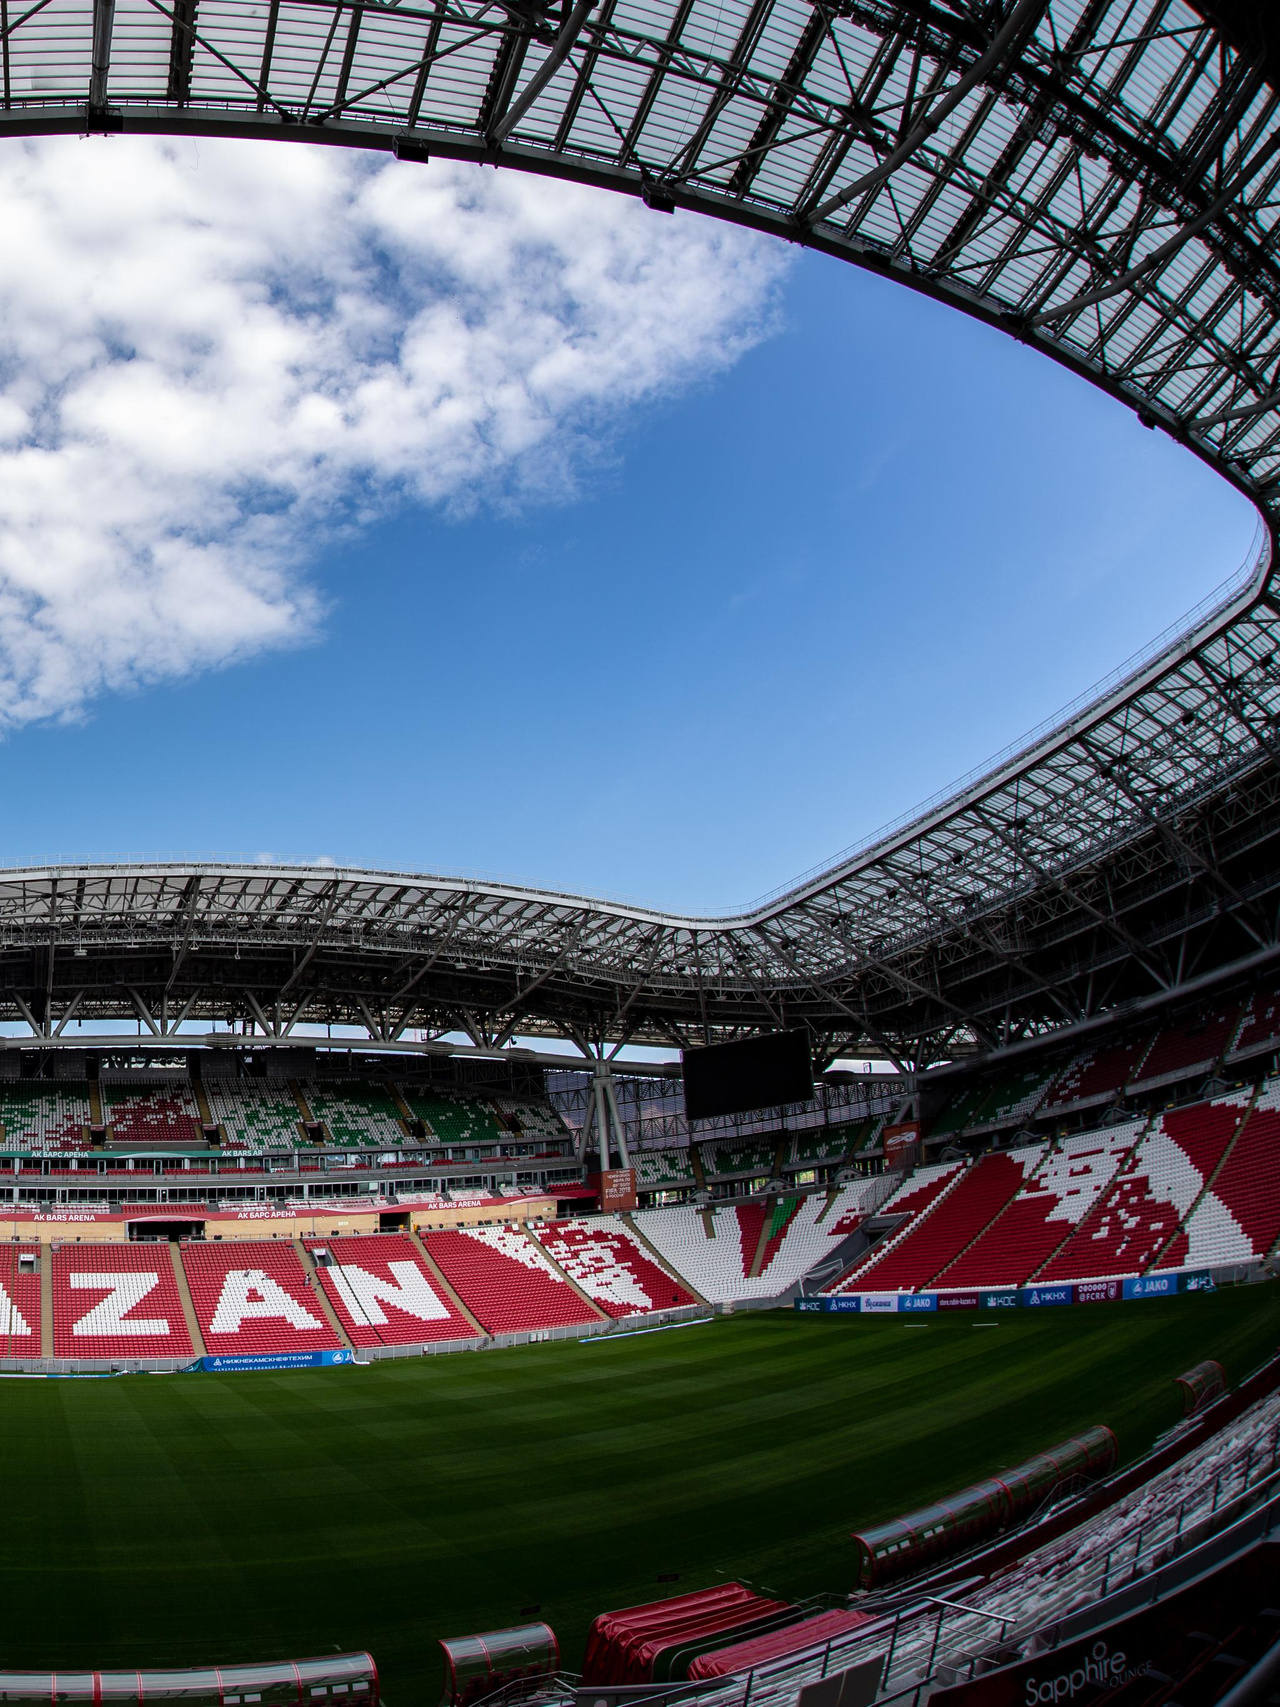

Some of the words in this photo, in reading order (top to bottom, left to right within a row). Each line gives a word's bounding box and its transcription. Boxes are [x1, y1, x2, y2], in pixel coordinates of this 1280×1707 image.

[1144, 1279, 1168, 1292] JAKO
[1079, 1292, 1105, 1302] @FCRK
[913, 1299, 930, 1307] JAKO
[1025, 1641, 1127, 1707] Sapphire
